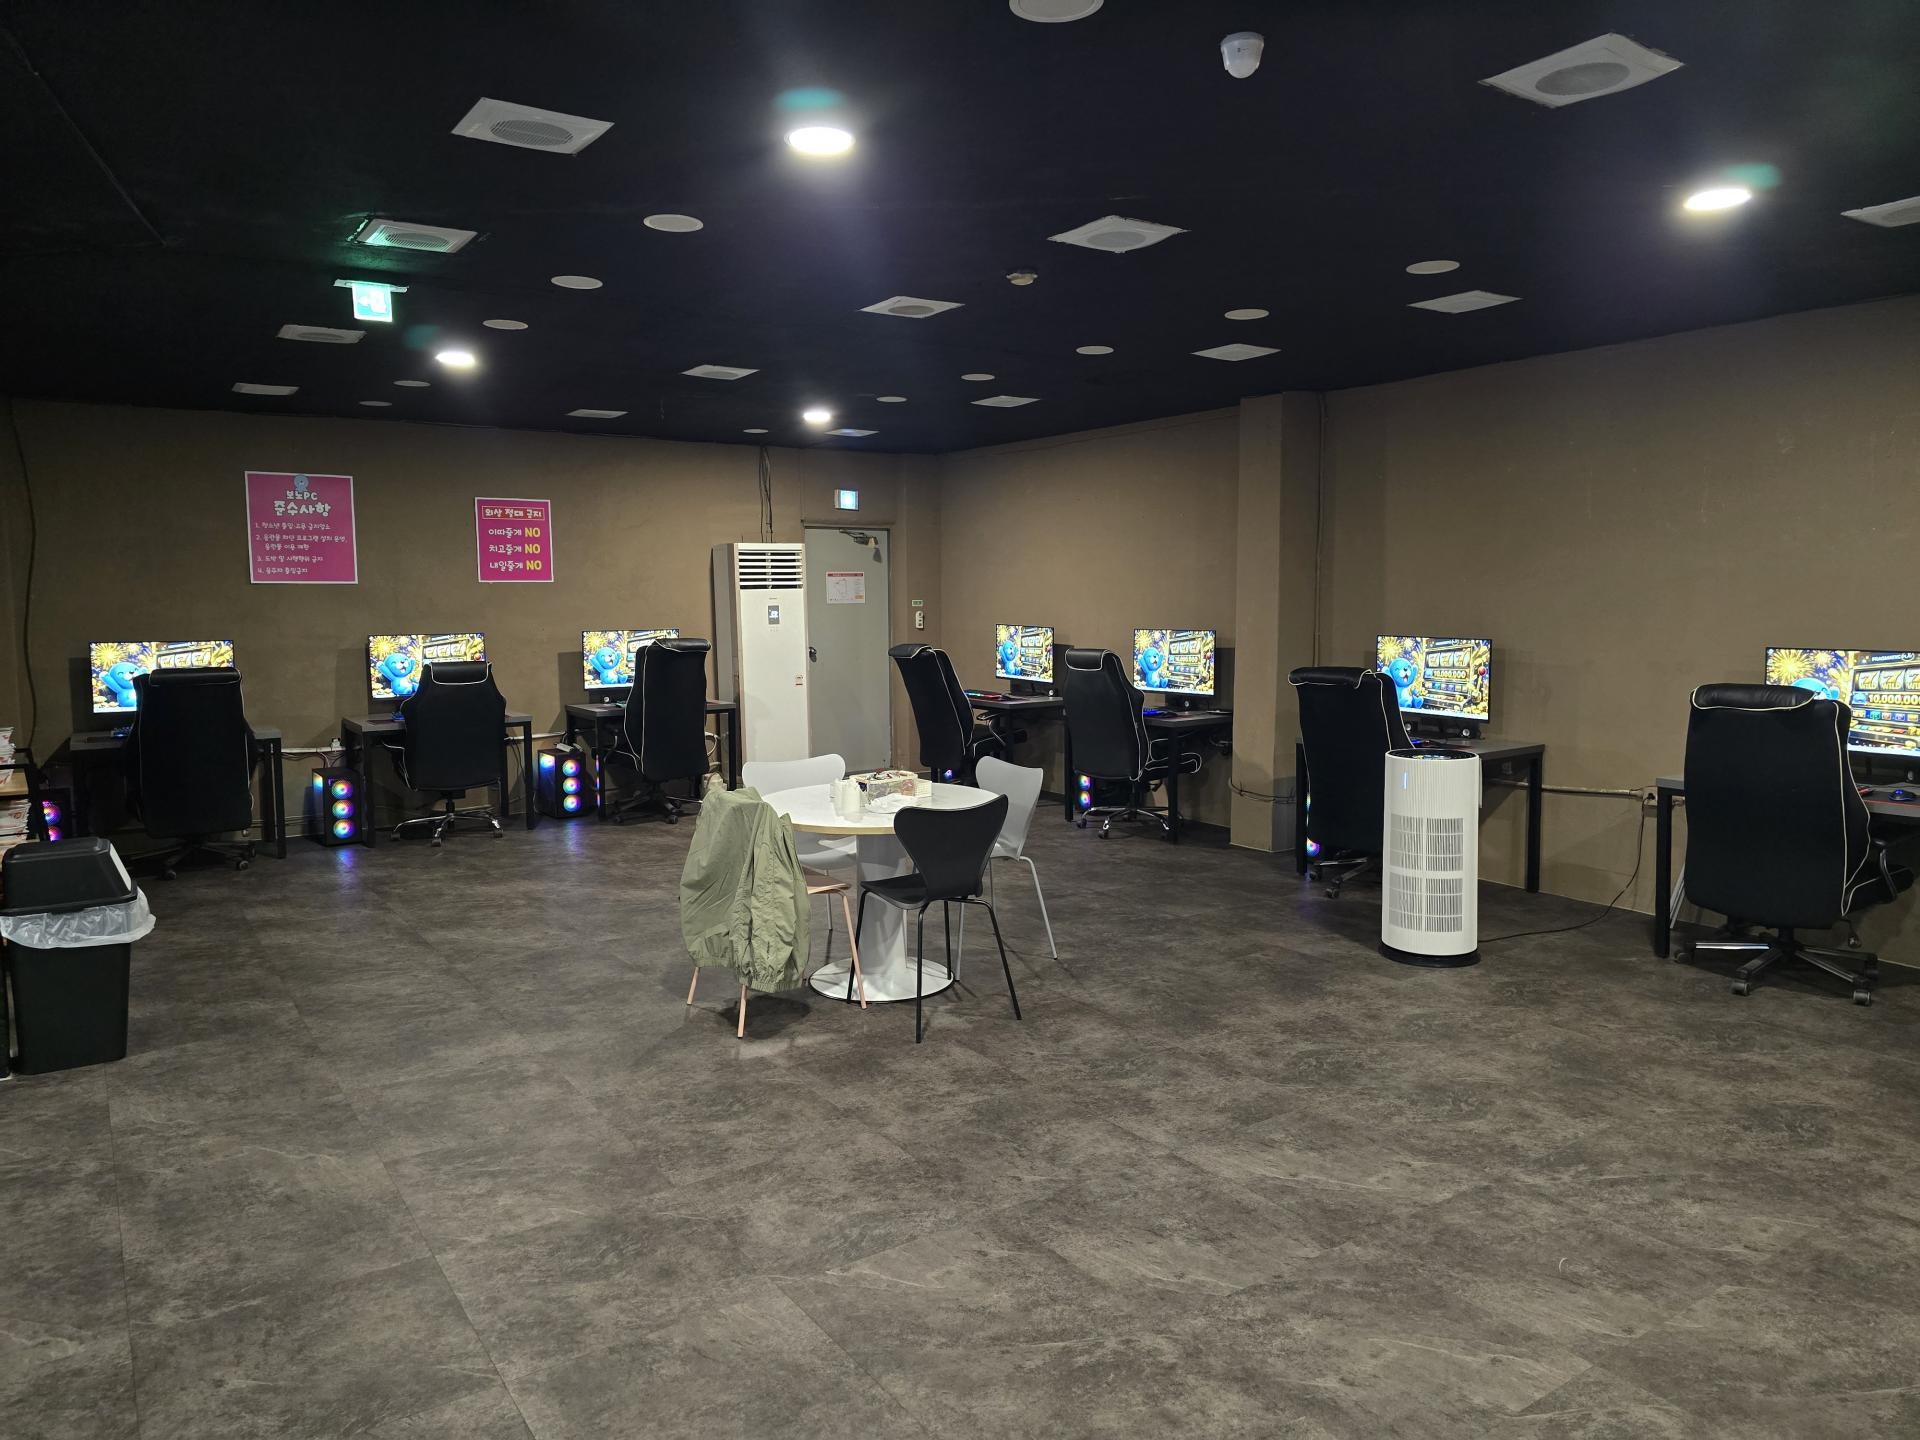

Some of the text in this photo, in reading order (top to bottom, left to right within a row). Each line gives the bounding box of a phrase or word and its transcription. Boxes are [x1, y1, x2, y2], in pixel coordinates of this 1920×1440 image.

[286, 490, 318, 500] 보노PC
[273, 500, 331, 517] 준수사항
[485, 508, 542, 518] 외상 절대 금지
[488, 527, 541, 539] 이따줄게 NO
[524, 543, 541, 554] NO
[489, 560, 542, 572] 내일줄게 NO
[1868, 693, 1920, 706] 10,000,00
